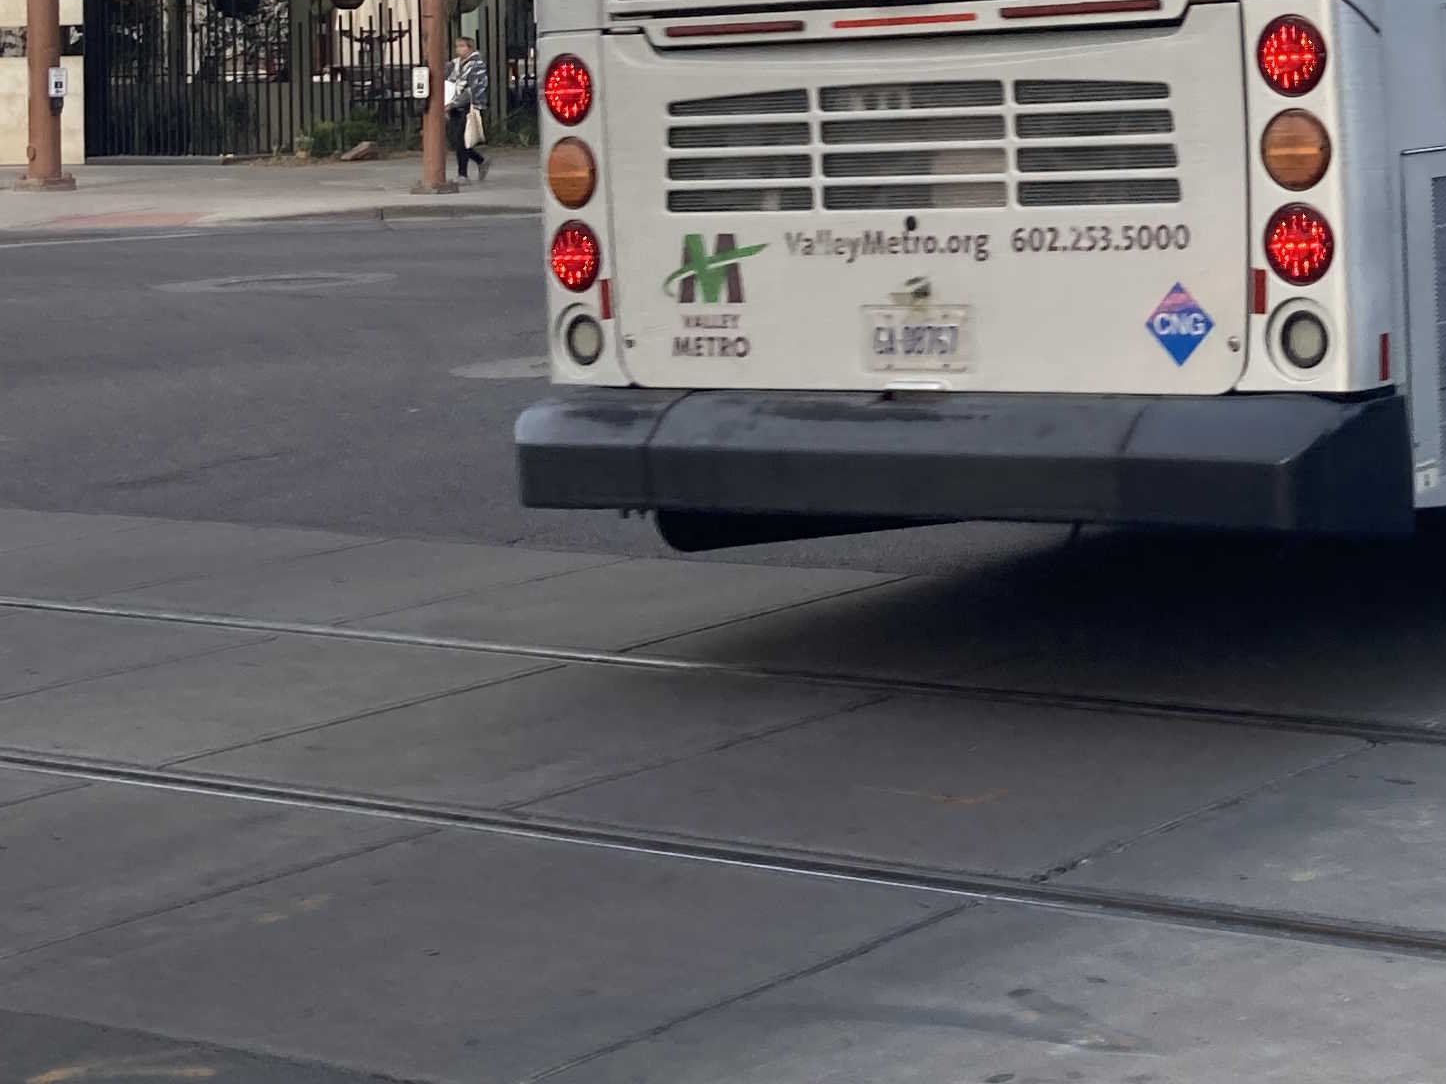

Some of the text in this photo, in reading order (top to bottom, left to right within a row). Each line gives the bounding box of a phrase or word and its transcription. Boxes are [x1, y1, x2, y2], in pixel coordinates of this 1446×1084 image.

[785, 224, 1191, 264] ValleyMetro.org 602.253.5000
[1153, 312, 1206, 335] CNG
[672, 336, 750, 357] METRO
